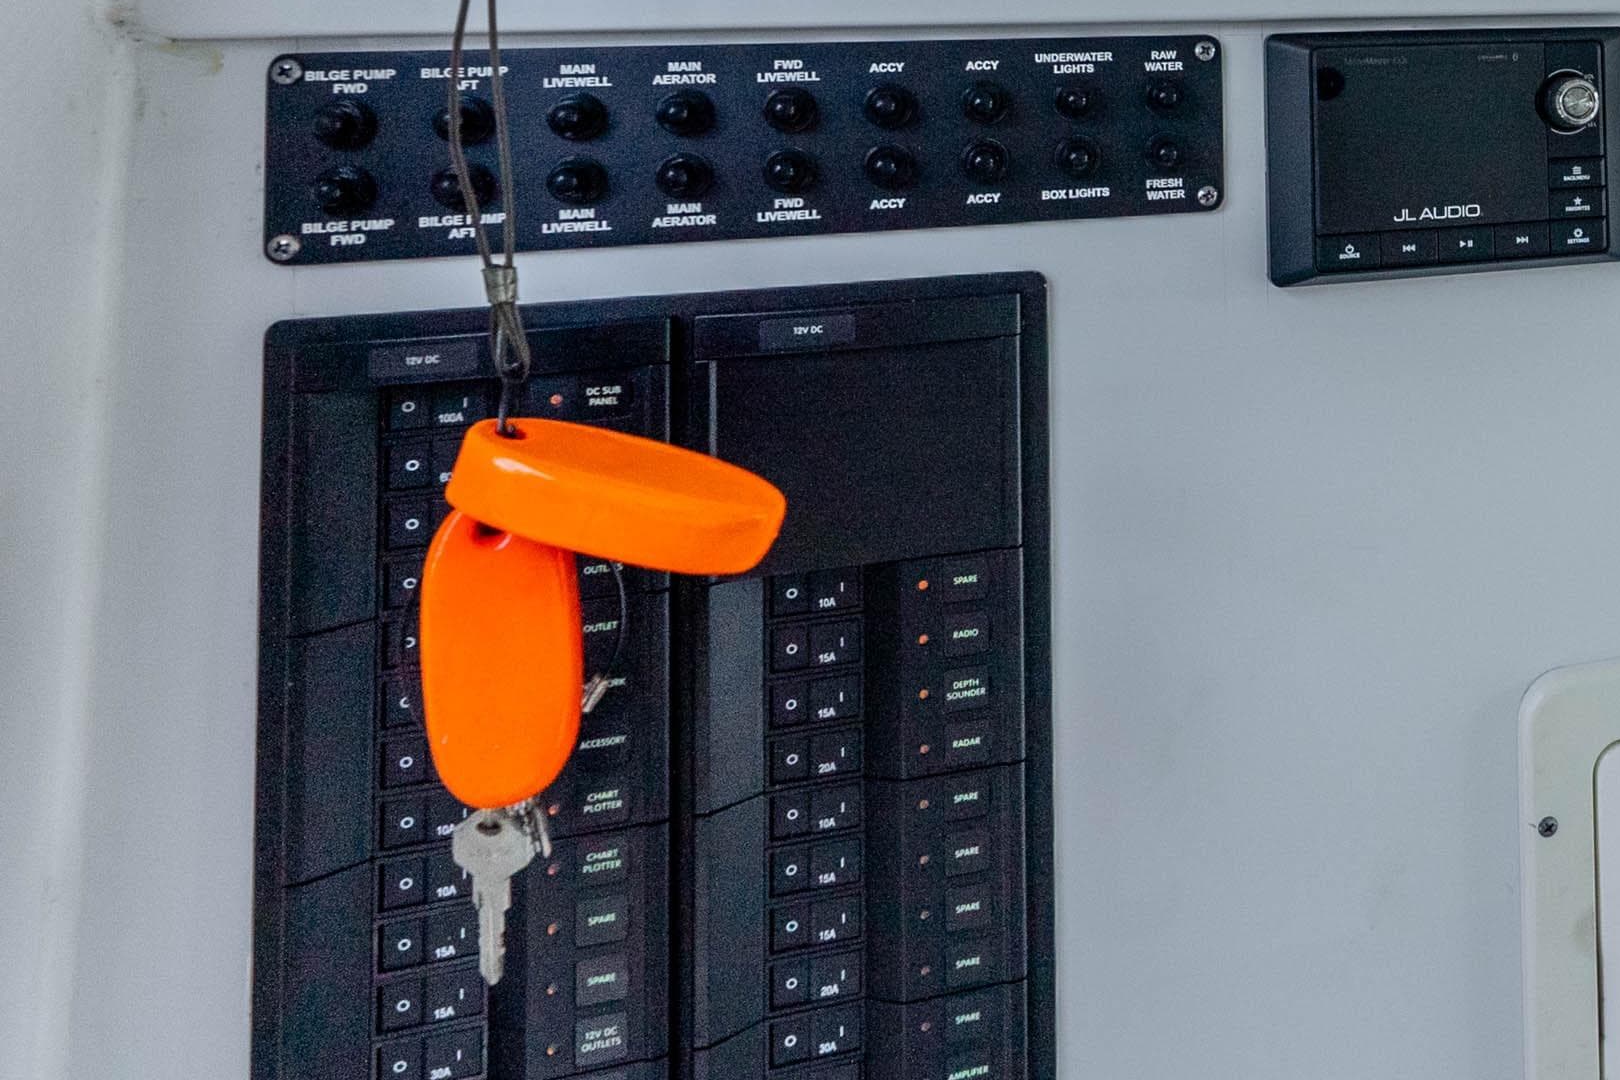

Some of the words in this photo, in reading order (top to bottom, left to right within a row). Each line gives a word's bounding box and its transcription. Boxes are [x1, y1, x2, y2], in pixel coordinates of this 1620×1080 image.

[1035, 52, 1112, 62] UNDERWATER
[1151, 51, 1176, 60] RAW
[560, 64, 595, 74] MAIN
[668, 62, 701, 71] MAIN
[774, 60, 803, 69] FWD
[870, 63, 904, 72] ACCY
[966, 61, 999, 70] ACCY
[1054, 64, 1094, 73] LIGHTS
[1145, 62, 1183, 71] WATER
[305, 70, 349, 81] BILGE
[354, 69, 396, 80] PUMP
[653, 74, 716, 85] AERATOR
[757, 72, 820, 82] LIVEWELL
[333, 83, 367, 93] FWD
[543, 77, 612, 88] LIVEWELL
[1146, 178, 1182, 188] FRESH
[967, 193, 1000, 204] ACCY
[1042, 190, 1066, 200] BOX
[1069, 187, 1109, 198] LIGHTS
[1147, 189, 1185, 200] WATER
[667, 203, 701, 214] MAIN
[775, 198, 803, 208] FWD
[870, 199, 905, 209] ACCY
[559, 209, 594, 219] MAIN
[757, 210, 821, 222] LIVEWELL
[1394, 209, 1416, 221] JL
[1420, 205, 1480, 219] AUDIO
[302, 221, 347, 234] BILGE
[351, 219, 394, 231] PUMP
[419, 215, 463, 227] BILGE
[652, 215, 716, 227] AERATOR
[542, 221, 611, 233] LIVEWELL
[331, 234, 365, 246] FWD
[811, 325, 822, 333] DC
[406, 357, 423, 365] 12V
[424, 355, 439, 364] DC
[586, 387, 600, 395] DC
[602, 386, 621, 394] SUB
[589, 397, 617, 405] PANEL
[439, 413, 463, 423] 100A
[954, 575, 977, 584] SPARE
[819, 598, 835, 607] 10A
[583, 620, 619, 633] OUTLET
[953, 629, 978, 638] RADIO
[819, 653, 835, 662] 15A
[953, 679, 979, 690] DEPTH
[947, 687, 985, 700] SOUNDER
[818, 708, 835, 717] 15A
[580, 736, 626, 749] ACCESSORY
[953, 737, 980, 747] RADAR
[587, 790, 619, 801] CHART
[954, 792, 978, 803] SPARE
[584, 799, 622, 812] PLOTTER
[819, 818, 835, 828] 10A
[587, 849, 619, 861] CHART
[955, 846, 978, 858] SPARE
[583, 859, 621, 873] PLOTTER
[819, 873, 835, 883] 15A
[437, 885, 456, 897] 10A
[956, 902, 979, 913] SPARE
[588, 913, 615, 926] SPARE
[820, 929, 835, 940] 15A
[436, 946, 455, 958] 15A
[956, 957, 979, 968] SPARE
[434, 1006, 454, 1019] 15A
[956, 1012, 980, 1024] SPARE
